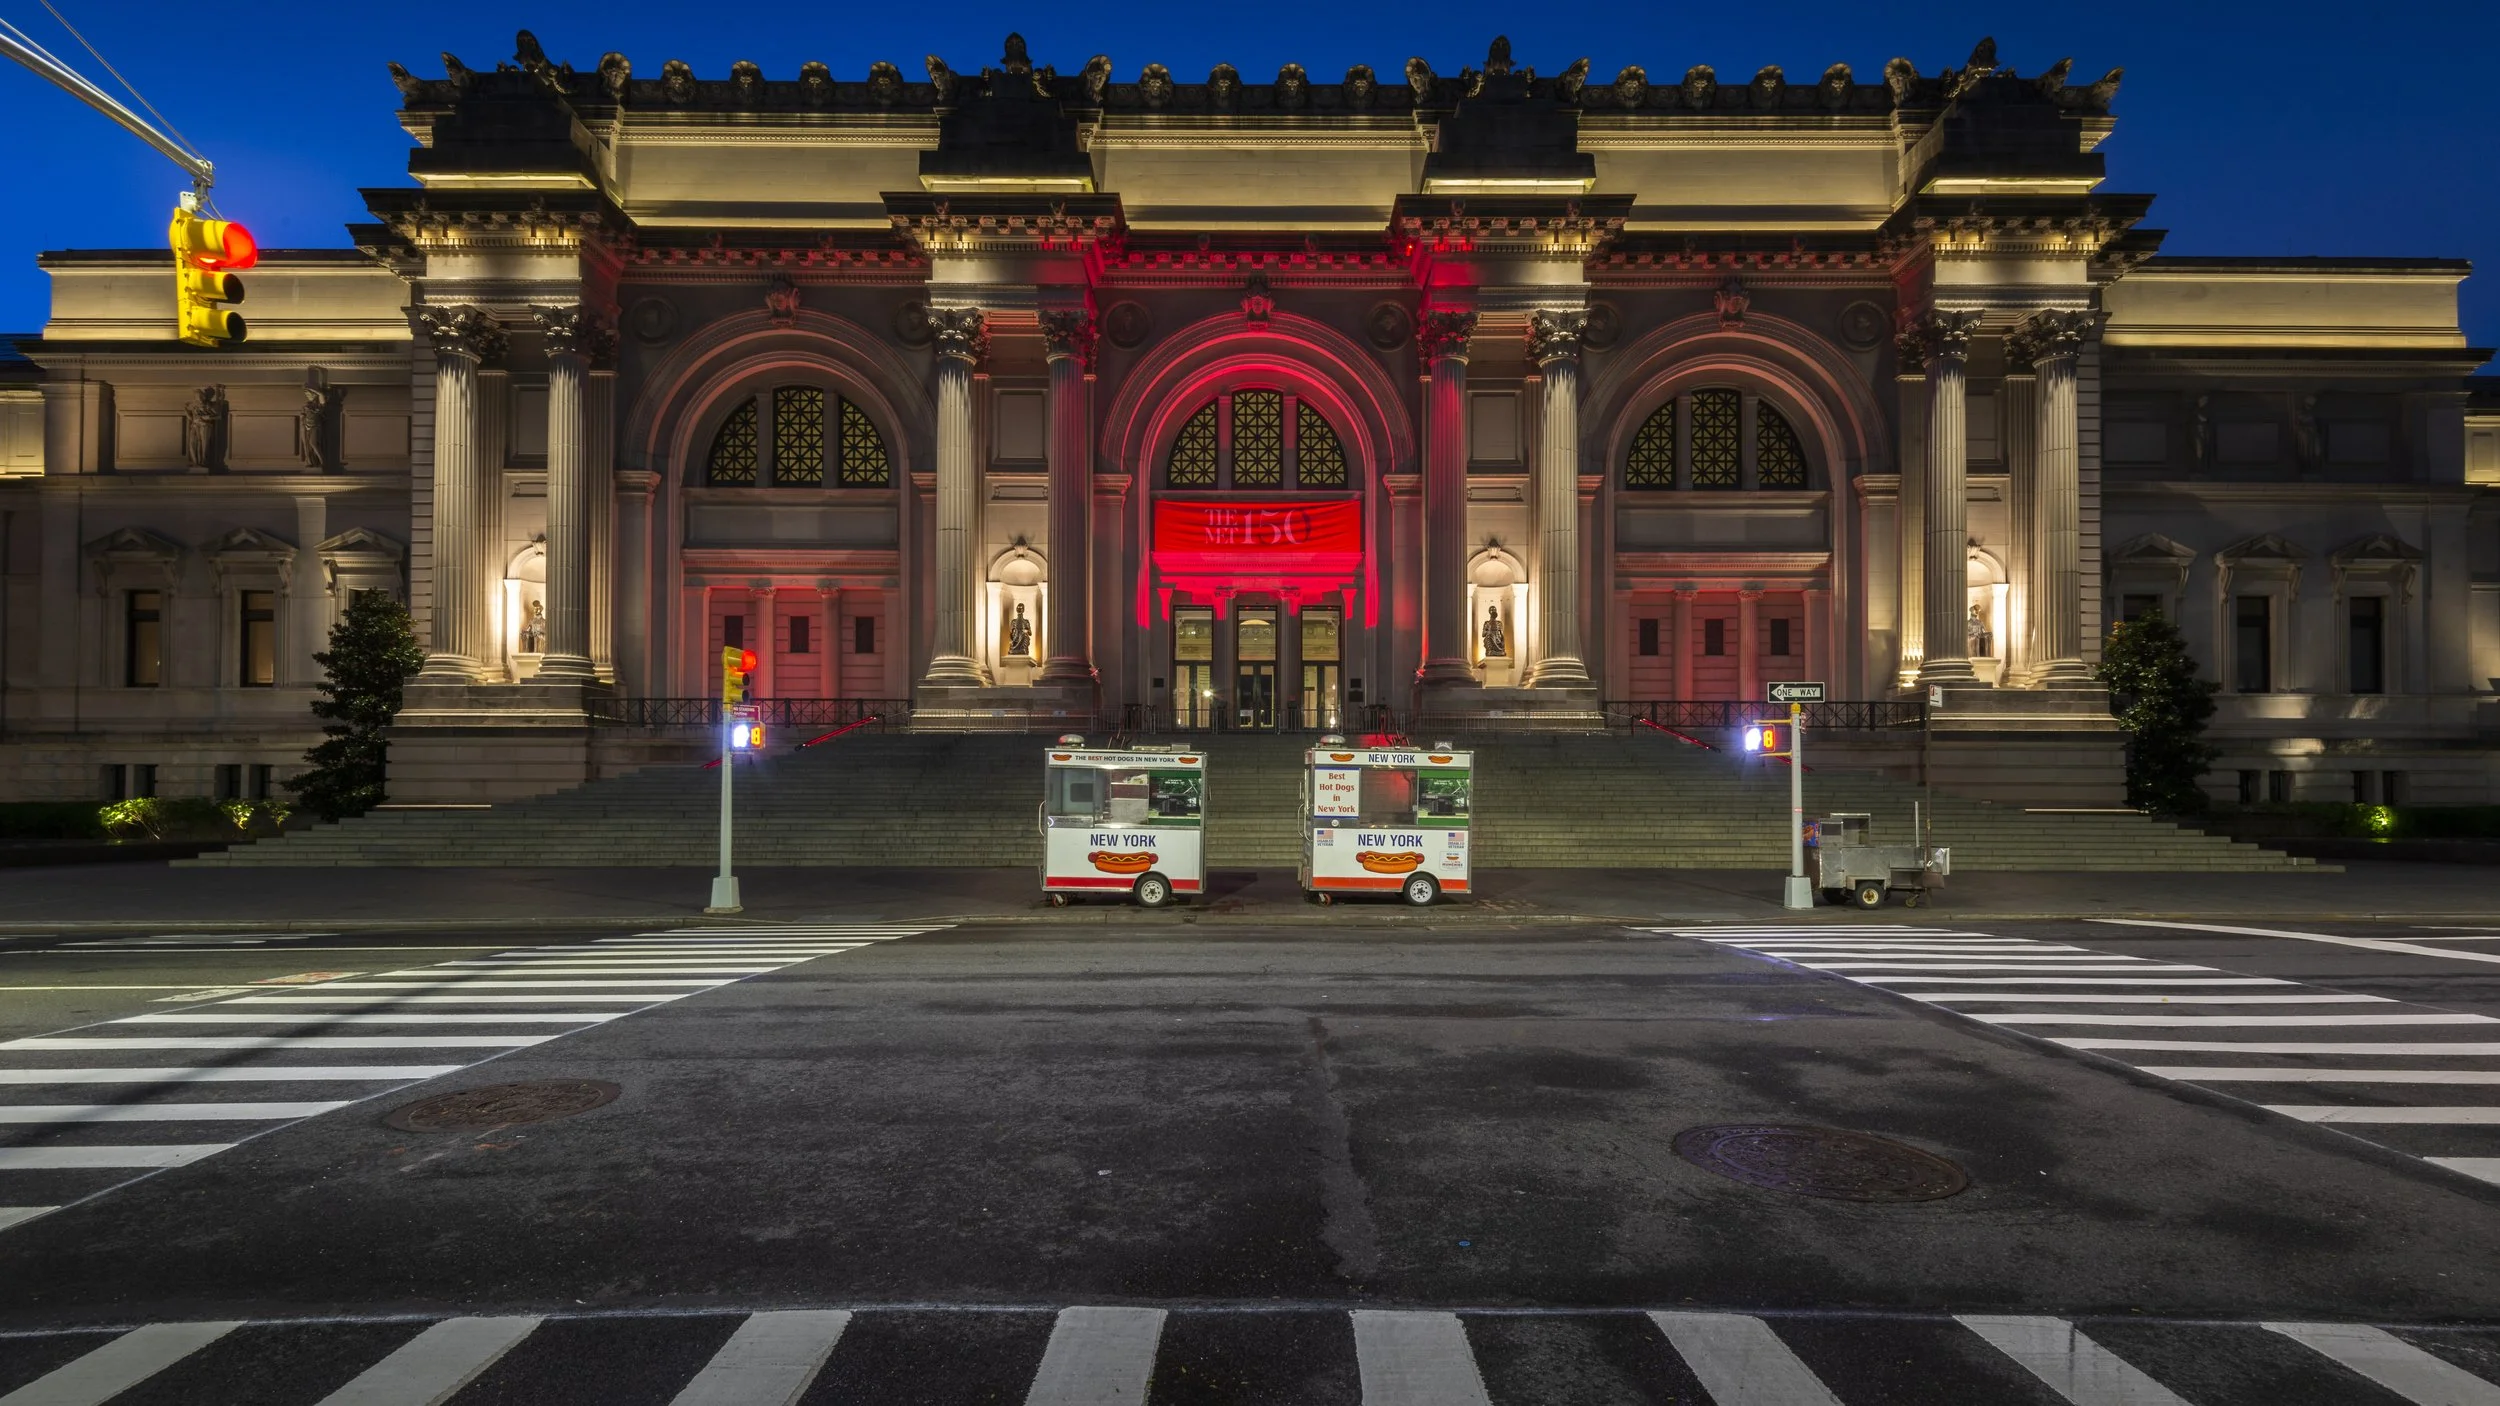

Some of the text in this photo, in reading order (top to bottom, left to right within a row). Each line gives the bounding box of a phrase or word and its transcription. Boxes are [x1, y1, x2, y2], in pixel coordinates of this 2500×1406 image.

[1205, 509, 1311, 545] THE 150
[1205, 528, 1239, 544] MET
[1777, 688, 1817, 696] ONE WAY
[1368, 754, 1416, 764] NEW YORK
[1335, 784, 1355, 792] Dogs
[1090, 834, 1156, 847] NEW YORK
[1358, 834, 1423, 847] NEW YORK
